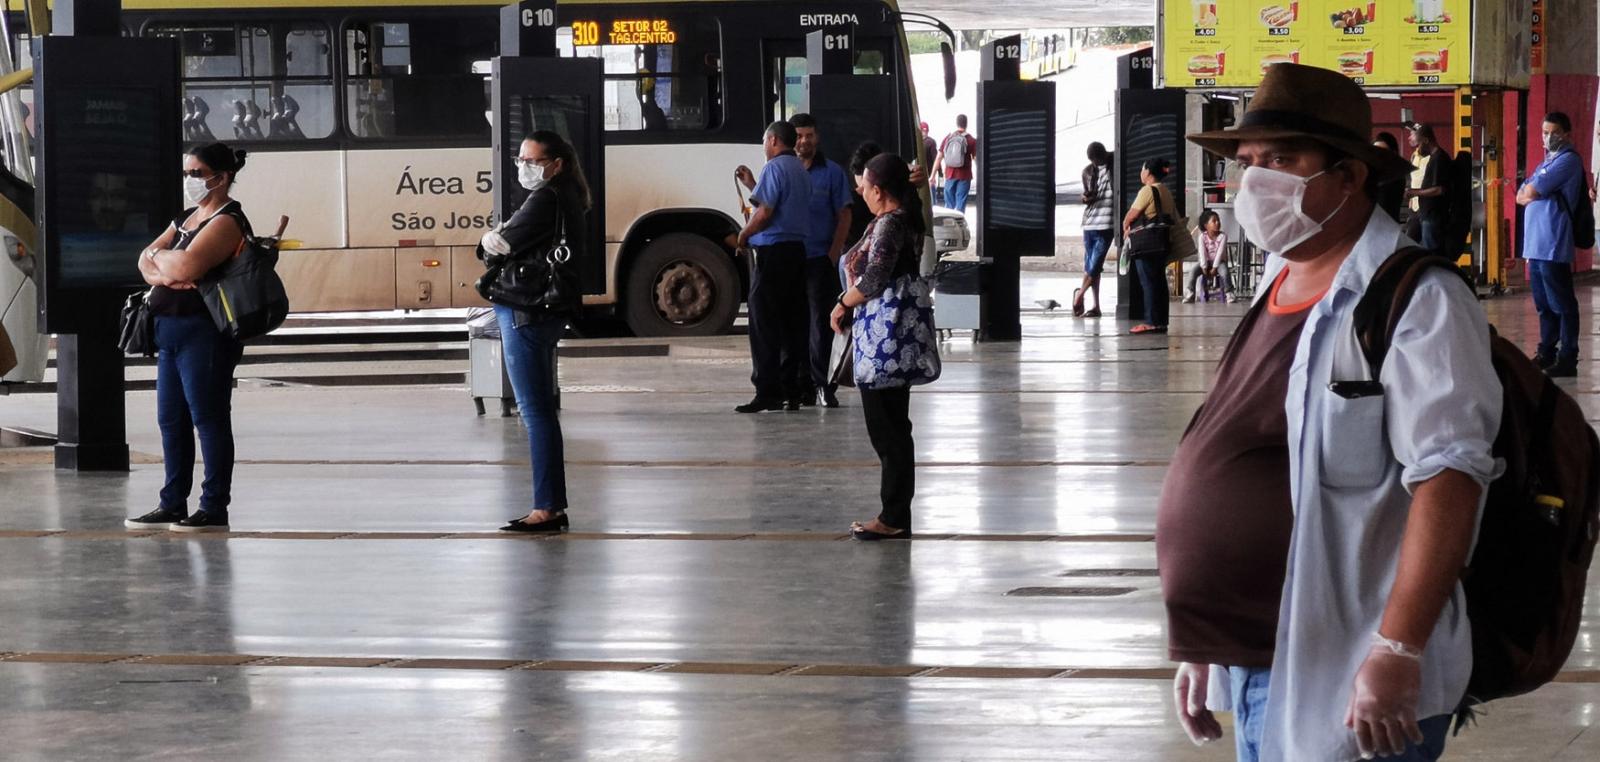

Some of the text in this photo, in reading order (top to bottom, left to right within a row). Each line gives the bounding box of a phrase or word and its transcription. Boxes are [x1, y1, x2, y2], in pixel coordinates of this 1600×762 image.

[522, 9, 553, 27] C 10
[800, 14, 859, 26] ENTRADA
[572, 22, 598, 45] 310
[613, 20, 668, 32] SETOR 02
[609, 32, 675, 44] TAG.CENTRO
[825, 34, 849, 50] C 11
[996, 45, 1019, 59] C 12
[1131, 57, 1152, 69] C 13
[396, 165, 493, 195] Área 5
[391, 210, 494, 230] São José
